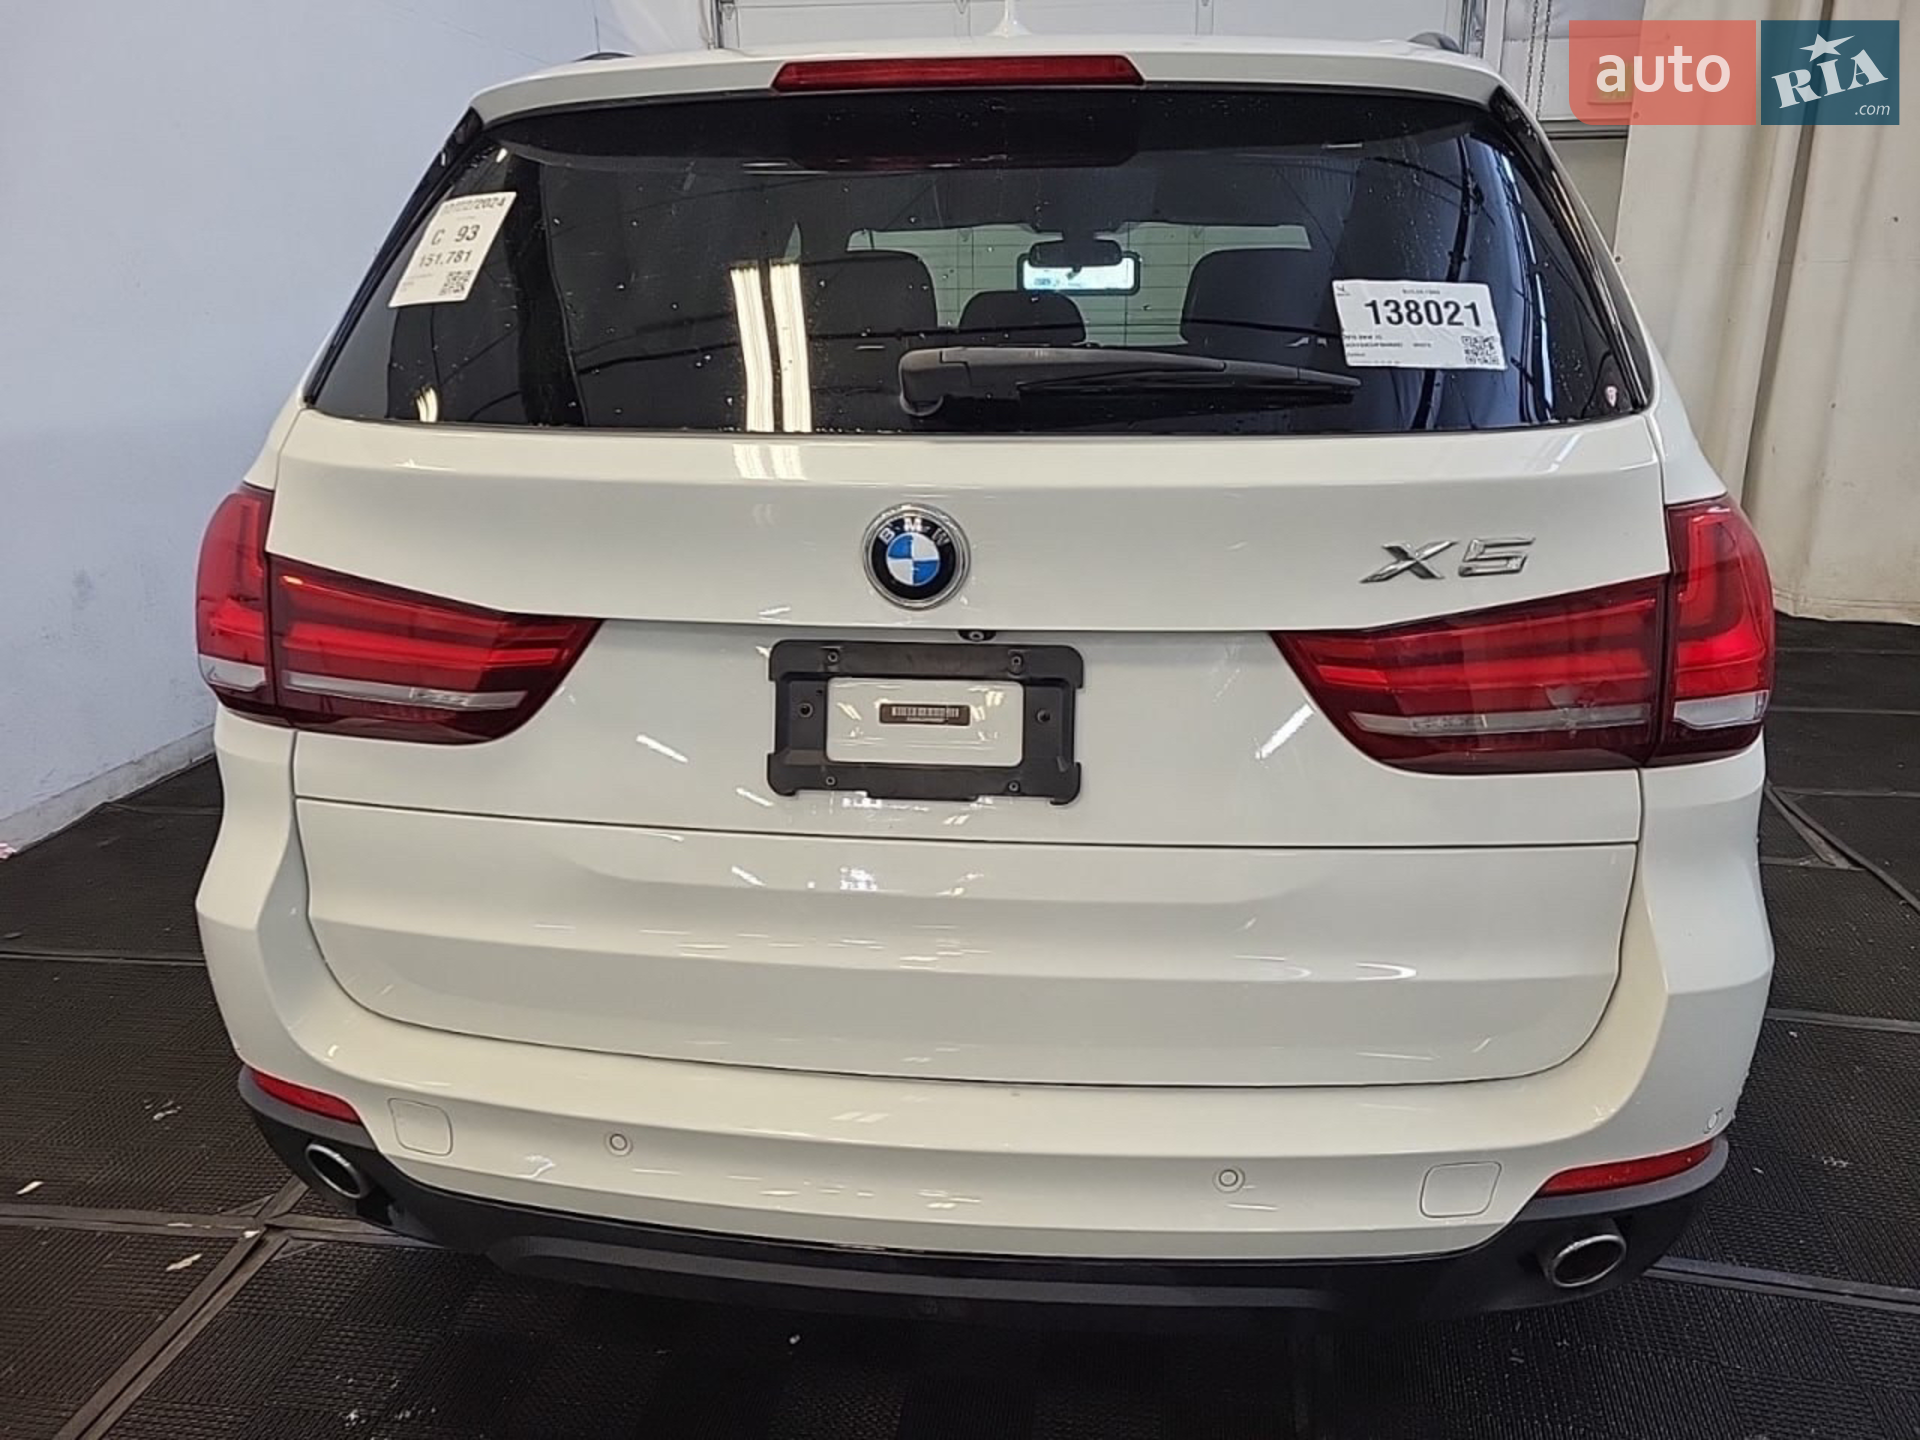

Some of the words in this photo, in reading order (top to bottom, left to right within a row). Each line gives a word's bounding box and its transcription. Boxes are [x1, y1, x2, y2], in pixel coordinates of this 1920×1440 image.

[454, 224, 481, 243] 93
[1364, 299, 1481, 327] 138021
[878, 517, 951, 547] BMW
[1359, 536, 1537, 584] X5
